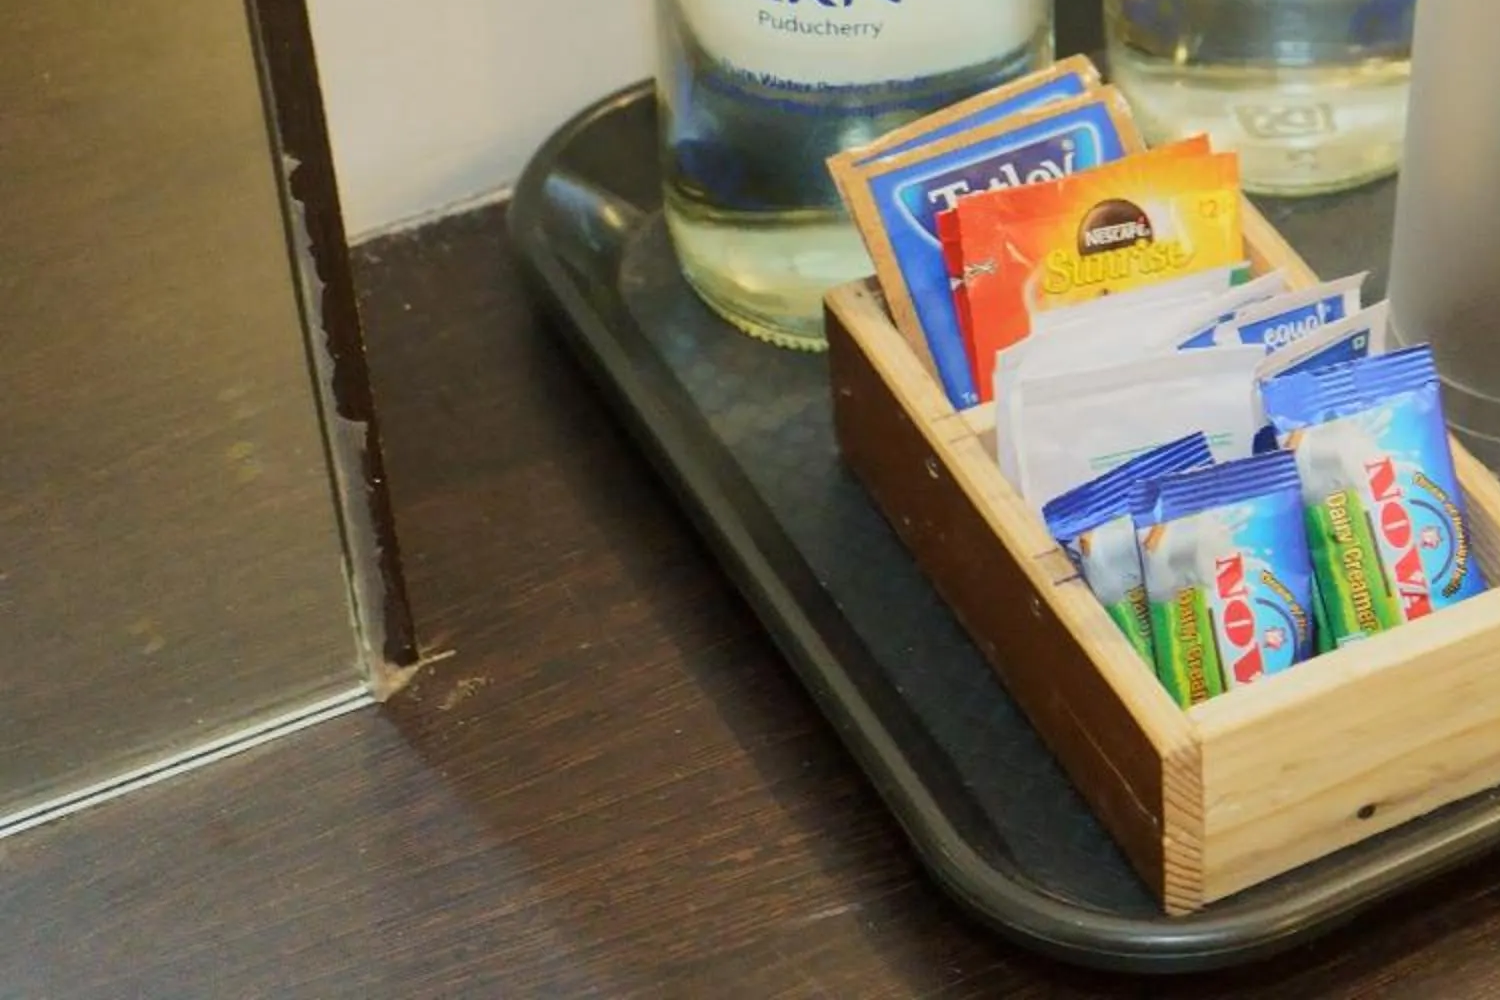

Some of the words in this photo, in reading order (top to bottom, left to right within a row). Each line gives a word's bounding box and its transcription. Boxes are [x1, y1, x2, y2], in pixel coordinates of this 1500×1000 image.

[757, 10, 884, 38] Puducherry
[928, 139, 1075, 212] Tley
[1043, 236, 1190, 295] Sunrise
[1325, 489, 1353, 545] Dairy
[1342, 543, 1380, 632] Creamer
[1363, 455, 1434, 622] NOVA
[1174, 586, 1202, 641] Dairy
[1214, 551, 1265, 684] NOV
